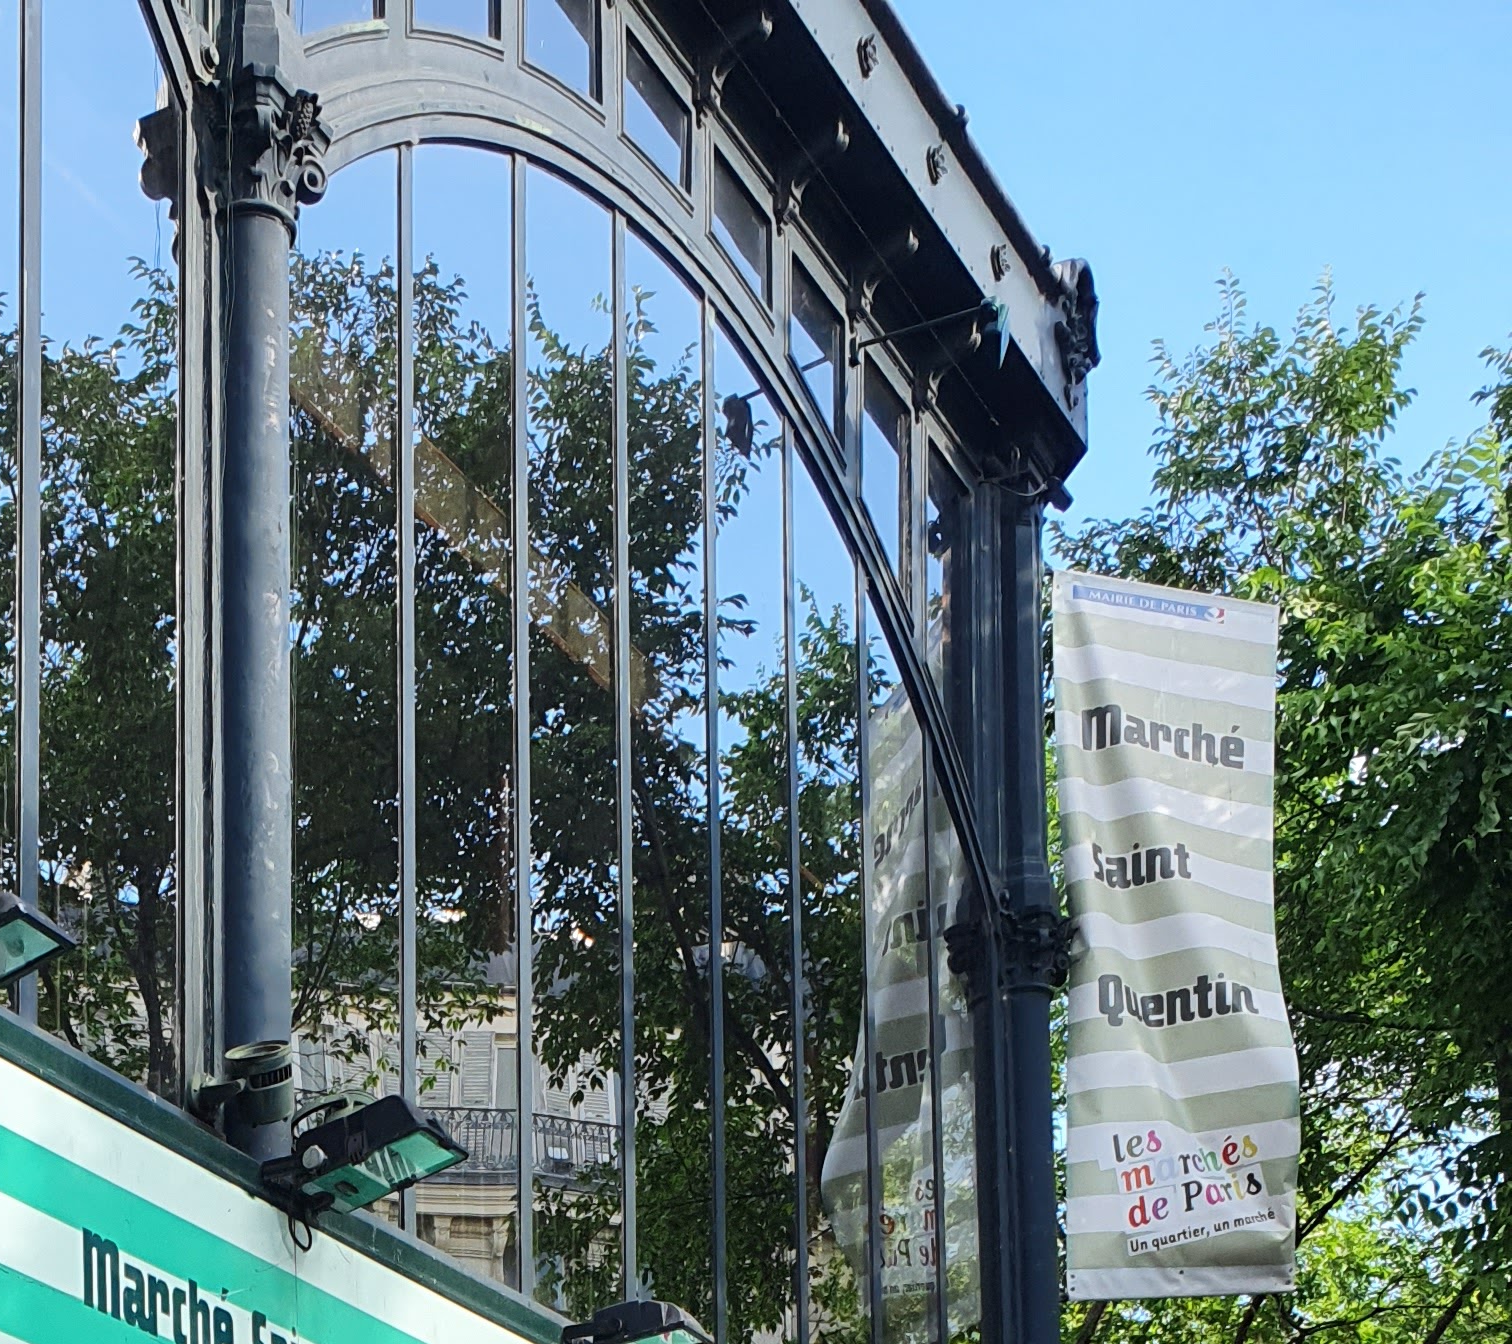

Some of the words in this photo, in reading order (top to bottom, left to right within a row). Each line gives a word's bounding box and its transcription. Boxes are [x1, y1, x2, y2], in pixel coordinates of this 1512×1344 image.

[1088, 590, 1136, 607] MAIRIE
[1139, 598, 1157, 609] DE
[1161, 601, 1197, 617] PARIS
[1081, 703, 1245, 770] Marché
[1091, 842, 1192, 889] Saint
[1098, 972, 1259, 1028] Quentin
[1113, 1129, 1162, 1163] les
[1121, 1135, 1258, 1192] marchés
[1128, 1195, 1170, 1228] de
[1181, 1172, 1262, 1212] Paris
[1130, 1238, 1148, 1252] Un
[1152, 1225, 1210, 1251] quartier,
[1214, 1219, 1230, 1232] un
[1234, 1207, 1275, 1228] marché
